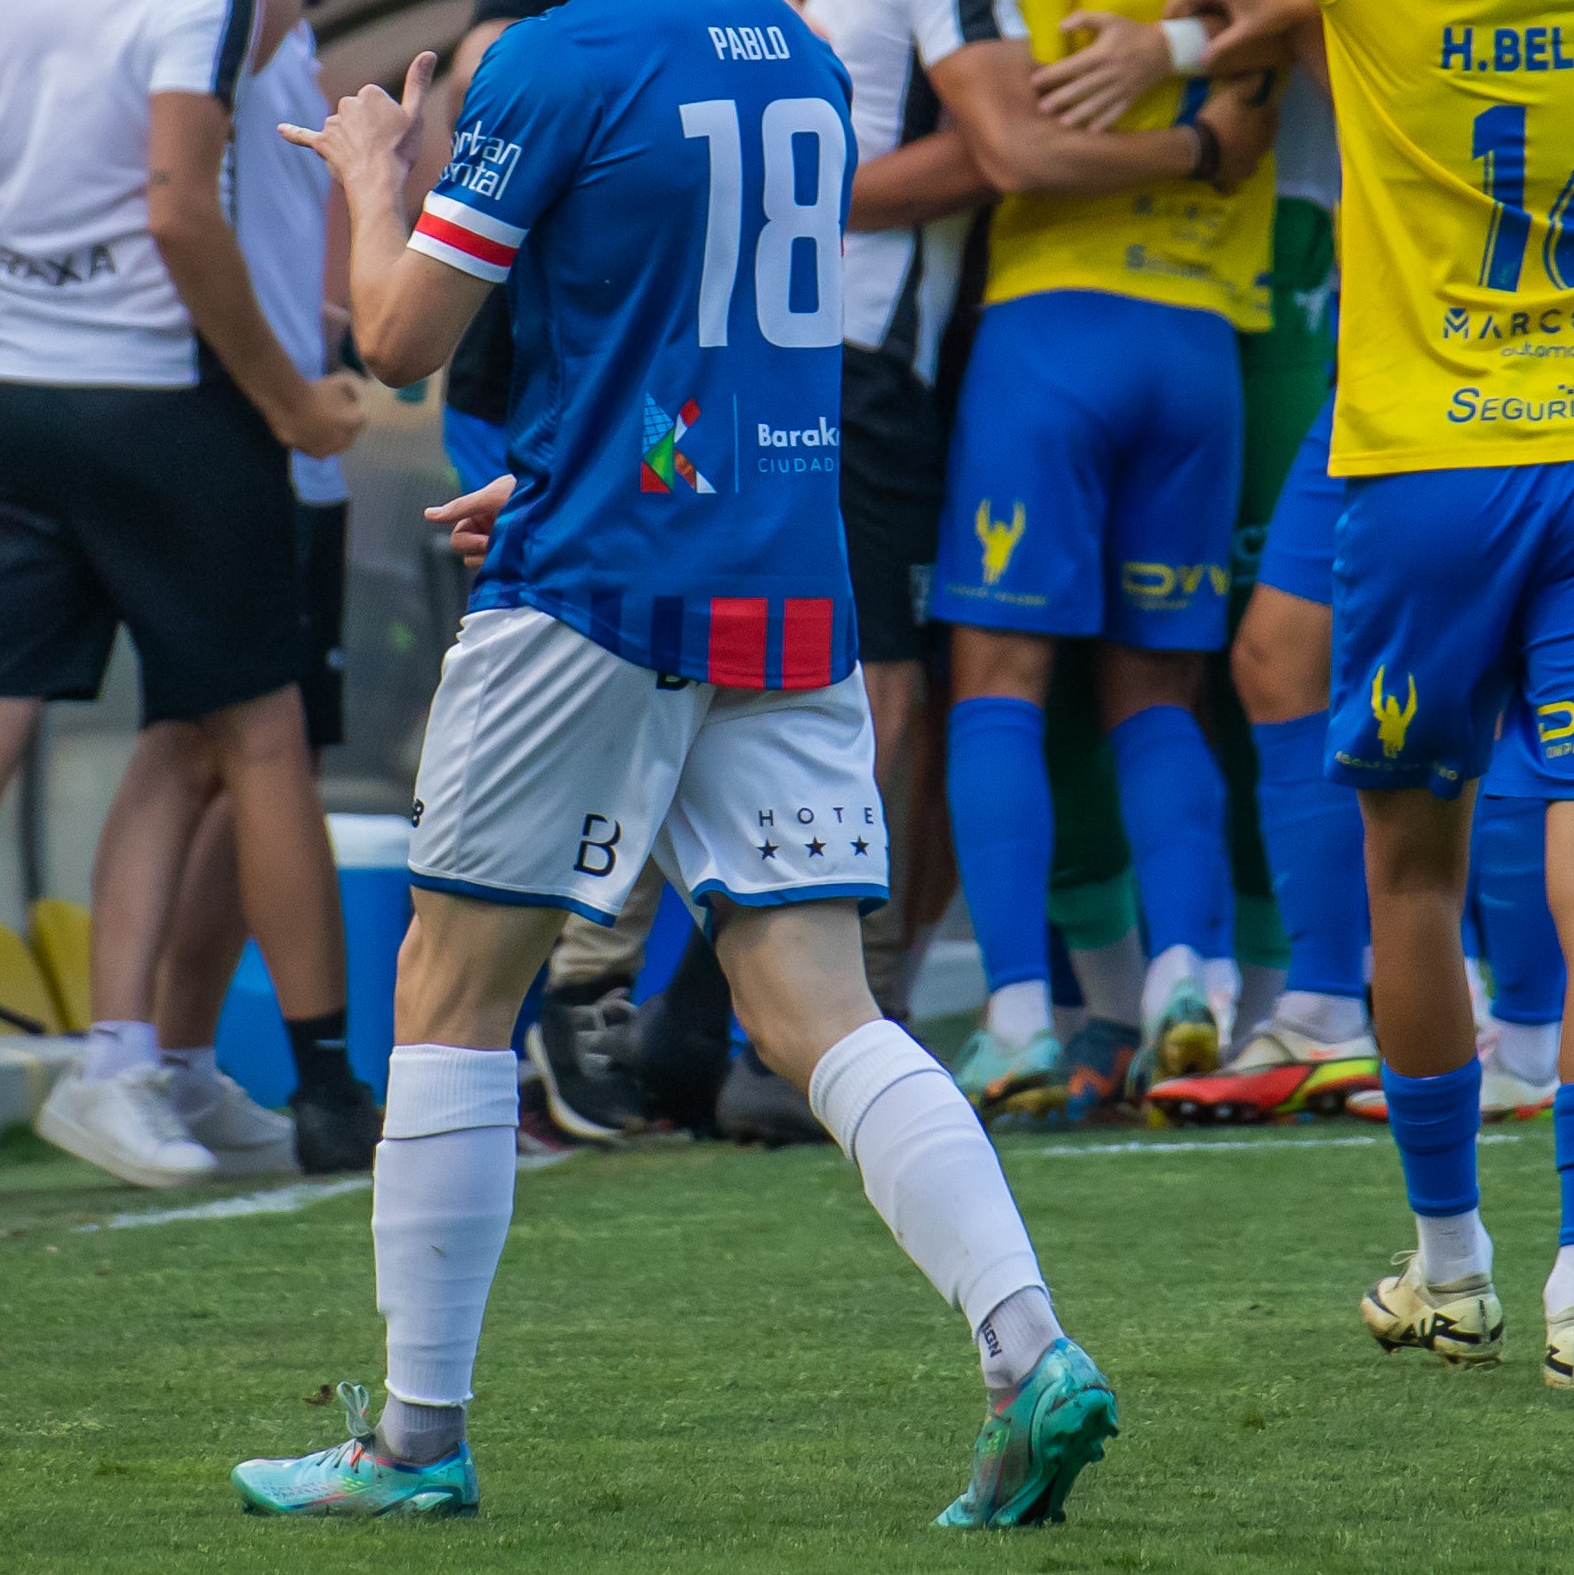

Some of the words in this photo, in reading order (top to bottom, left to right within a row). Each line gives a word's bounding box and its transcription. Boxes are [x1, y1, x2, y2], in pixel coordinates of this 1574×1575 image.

[708, 26, 790, 62] PABLO
[679, 97, 848, 348] 18
[758, 457, 834, 473] CIUDAD
[759, 806, 874, 827] HOTE
